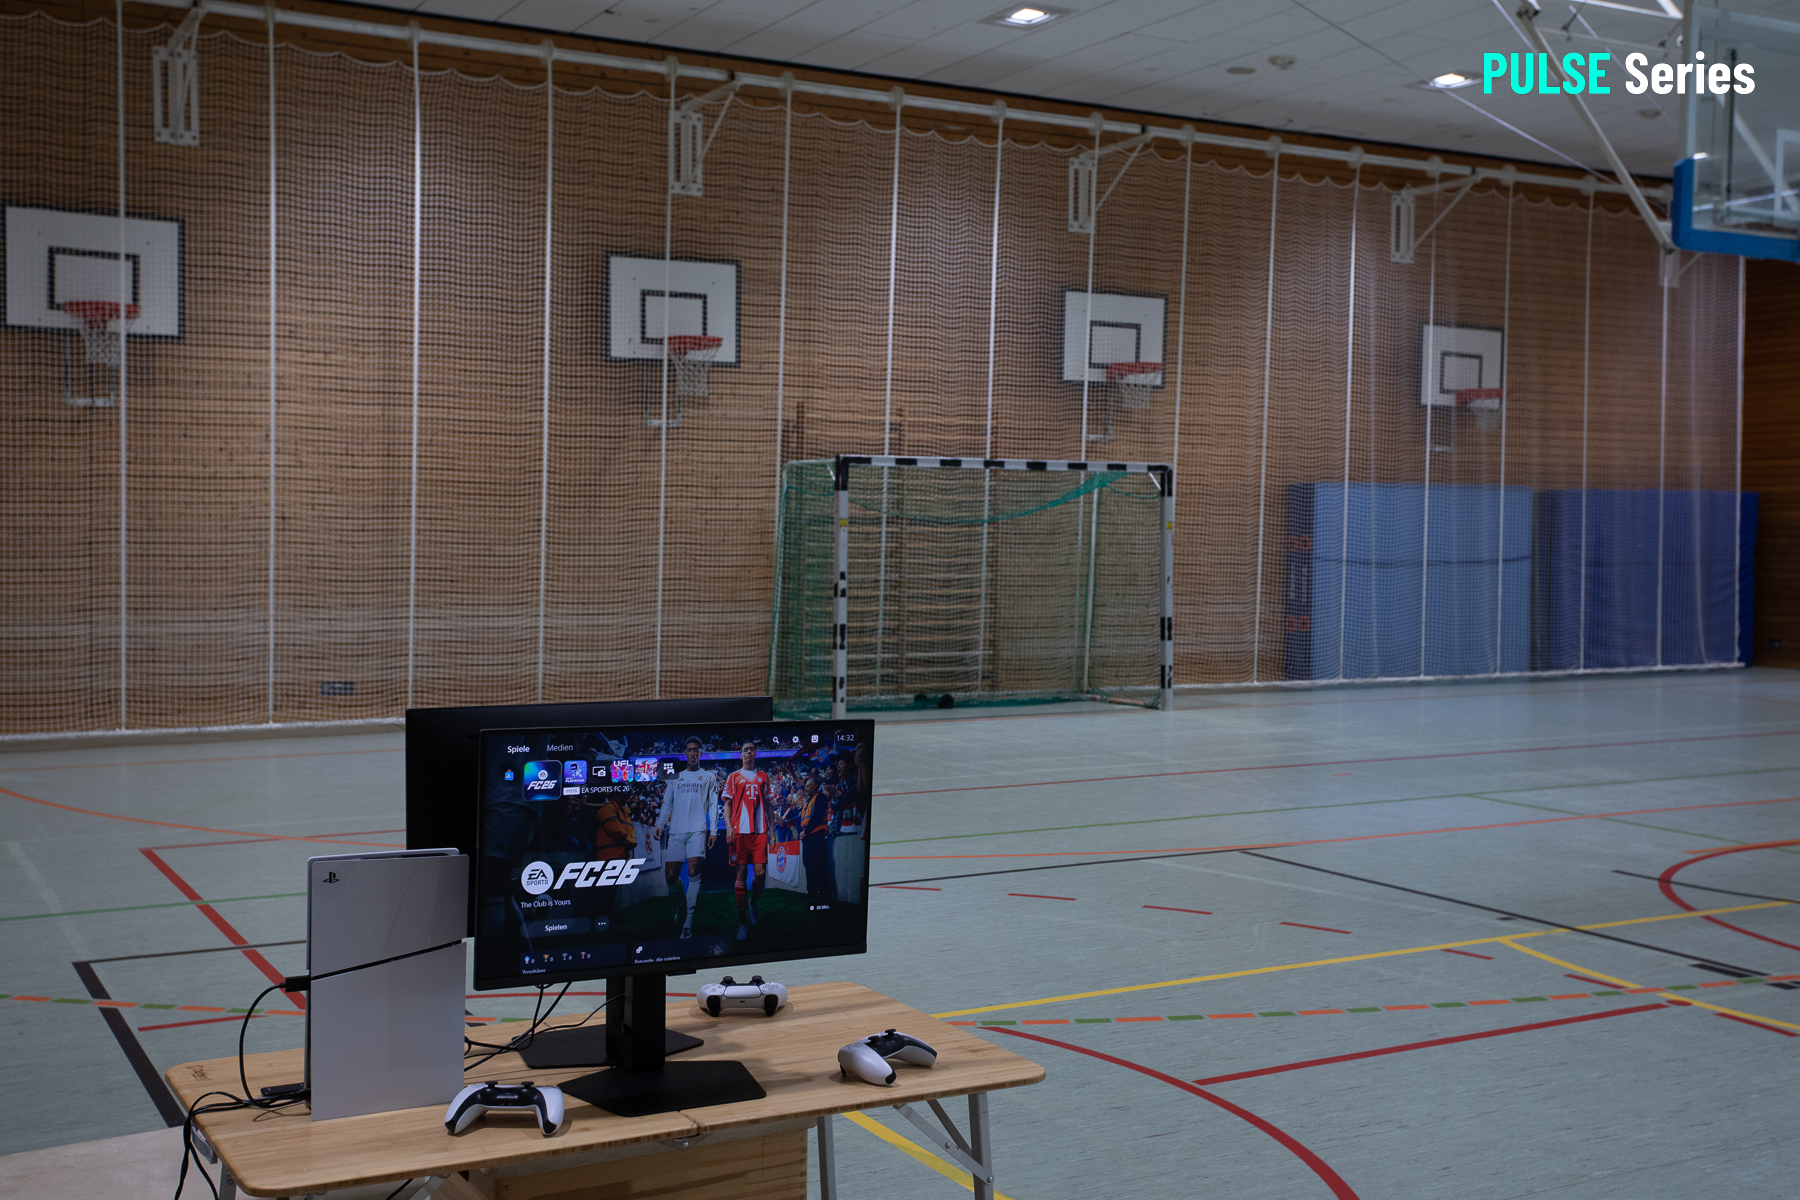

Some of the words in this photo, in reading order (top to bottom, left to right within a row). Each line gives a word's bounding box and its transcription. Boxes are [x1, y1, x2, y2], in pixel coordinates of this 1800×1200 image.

[836, 734, 855, 742] 14:32
[507, 745, 530, 754] Spiele
[527, 780, 557, 790] FC26
[527, 868, 548, 880] EA
[553, 858, 646, 890] FC26
[521, 901, 533, 909] The
[533, 900, 547, 908] Club
[545, 924, 567, 932] Spielen
